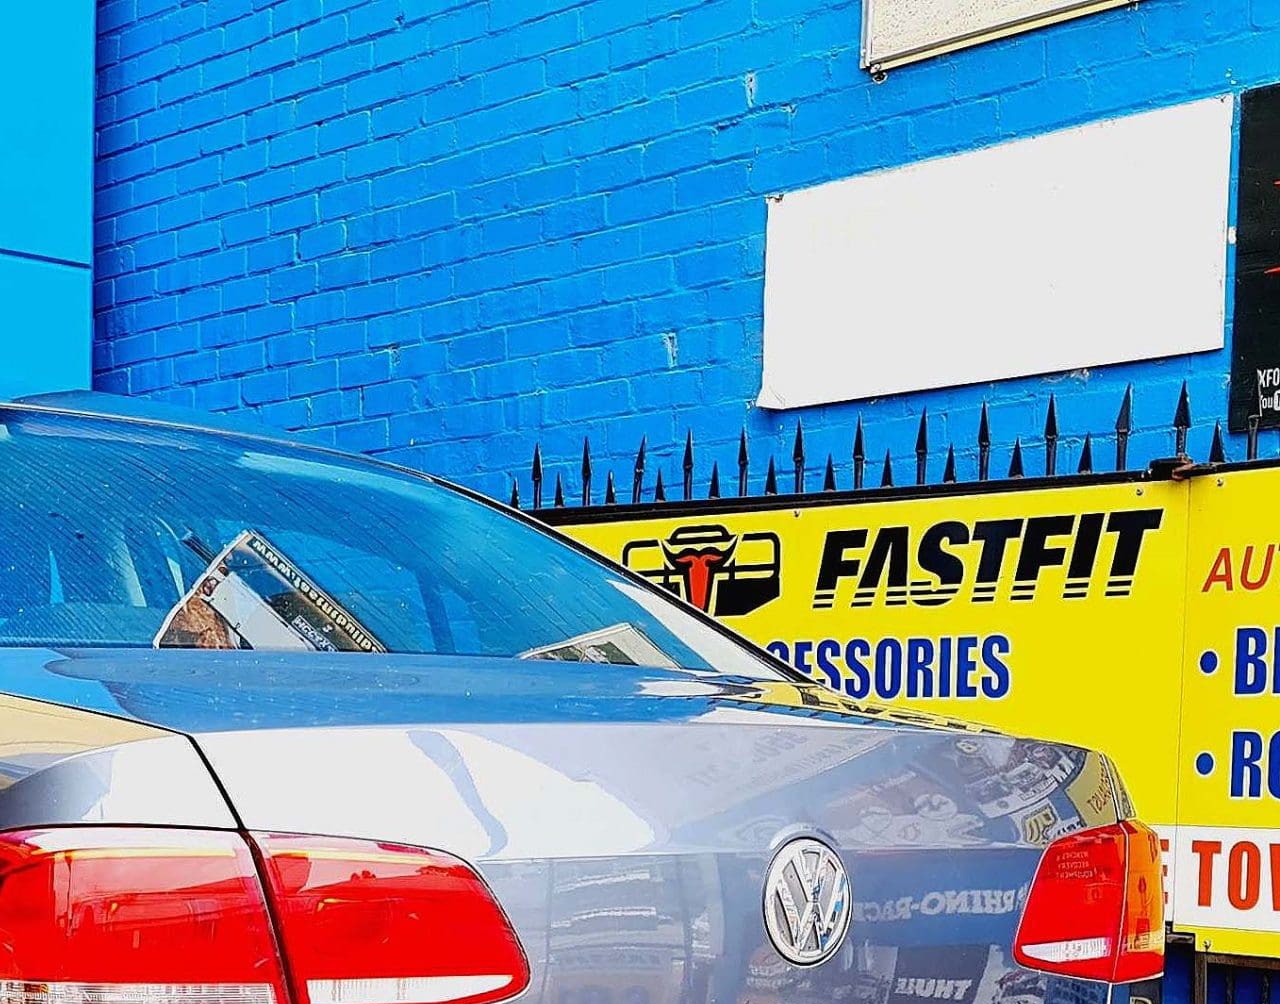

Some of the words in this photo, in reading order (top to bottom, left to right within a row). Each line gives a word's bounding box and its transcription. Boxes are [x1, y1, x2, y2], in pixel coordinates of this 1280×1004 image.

[812, 509, 1163, 609] FASTFIT
[1202, 544, 1280, 592] AU
[1235, 627, 1280, 695] B
